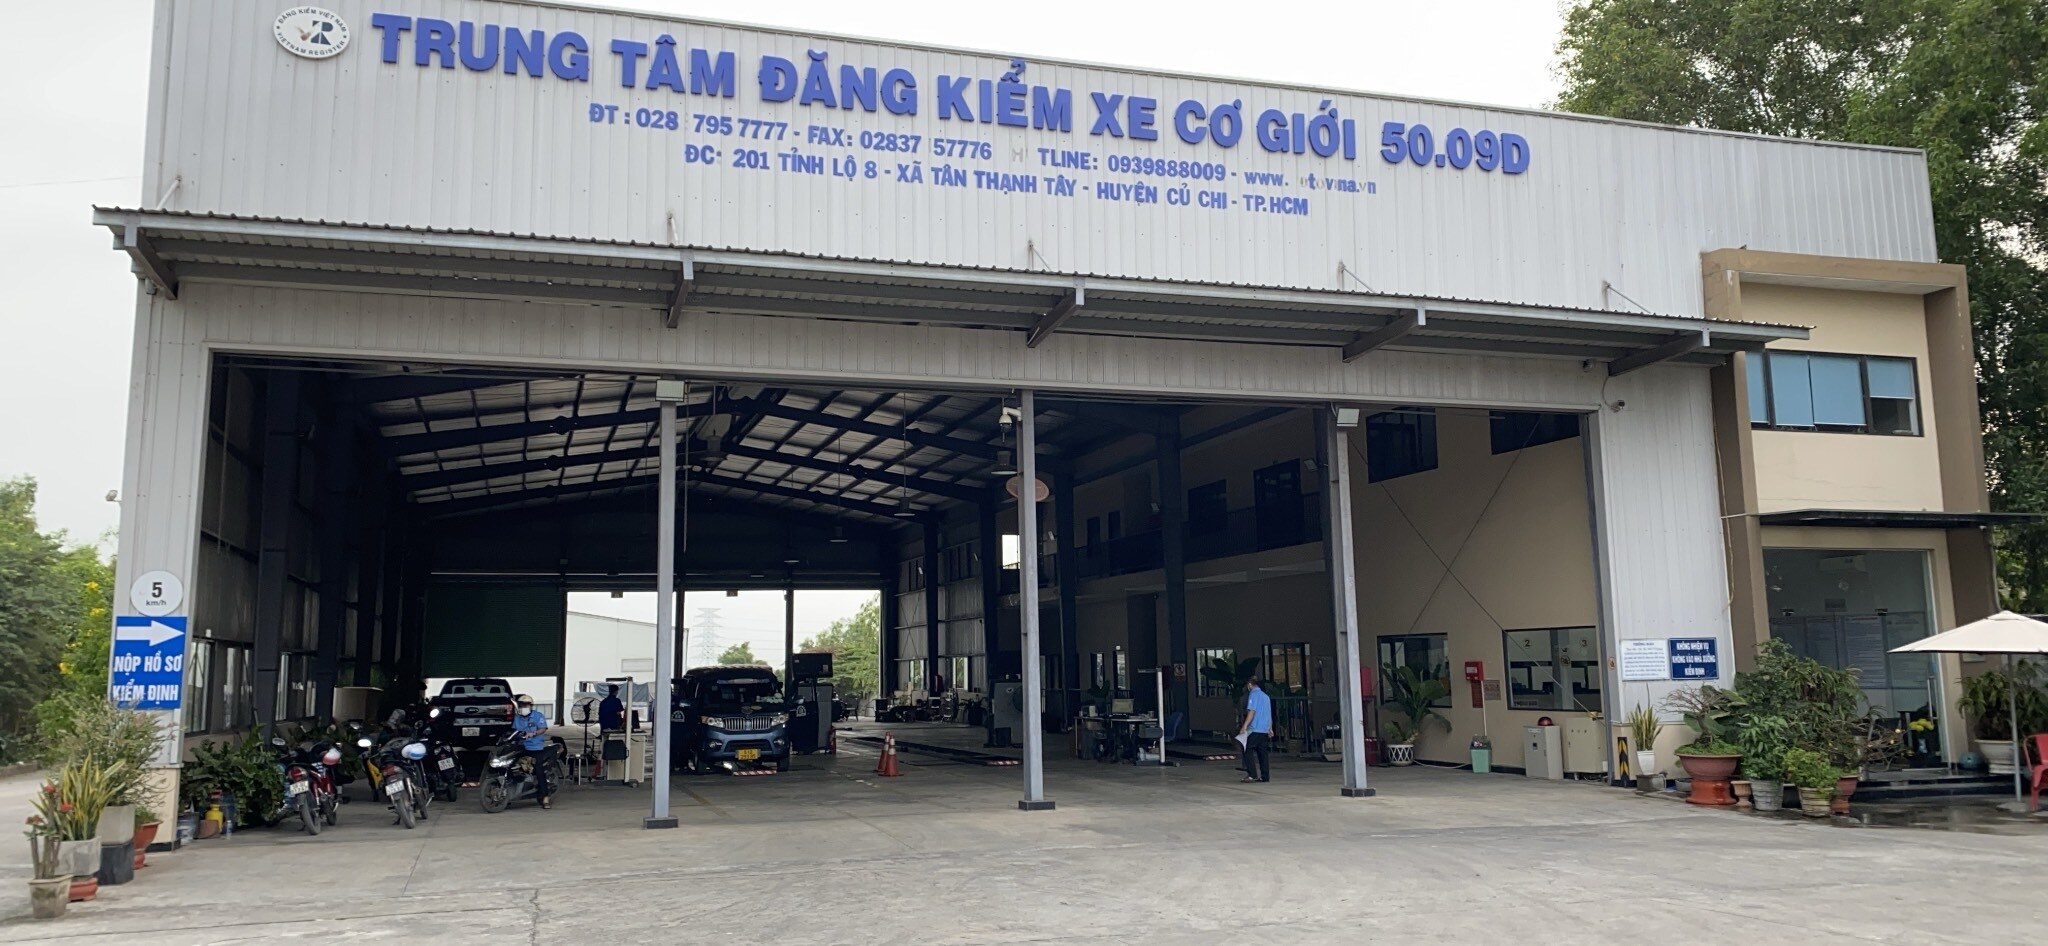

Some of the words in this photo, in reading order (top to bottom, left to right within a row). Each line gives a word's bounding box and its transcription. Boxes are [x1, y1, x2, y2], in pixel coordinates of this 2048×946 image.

[308, 41, 345, 55] REGISTER
[372, 13, 589, 82] TRUNG
[611, 34, 735, 99] TÂM
[759, 49, 918, 116] ĐĂNG
[937, 58, 1072, 133] KIỂM
[1090, 92, 1158, 141] XE
[1174, 99, 1243, 149] CƠ
[1257, 100, 1356, 159] GIỚI
[1380, 122, 1530, 175] 50.09D
[636, 108, 679, 130] 028
[738, 118, 788, 140] 7777
[807, 125, 852, 147] FAX:
[1108, 154, 1226, 181] 0939888009
[732, 148, 770, 170] 201
[777, 147, 824, 175] TỈNH
[832, 155, 857, 181] LỘ
[864, 160, 877, 179] 8
[897, 160, 923, 184] XÃ
[931, 164, 967, 187] TÂN
[973, 170, 1037, 195] THẠNH
[1044, 174, 1077, 197] TÂY
[1097, 181, 1158, 206] HUYỆN
[1167, 182, 1191, 206] CỦ
[1198, 190, 1227, 210] CHI
[1242, 193, 1309, 216] TP.HCM
[151, 582, 163, 598] 5
[145, 599, 167, 607] km/h
[114, 652, 141, 675] NỘP
[164, 654, 183, 672] SƠ
[112, 678, 144, 700] KIỂM
[147, 684, 179, 705] ĐỊNH
